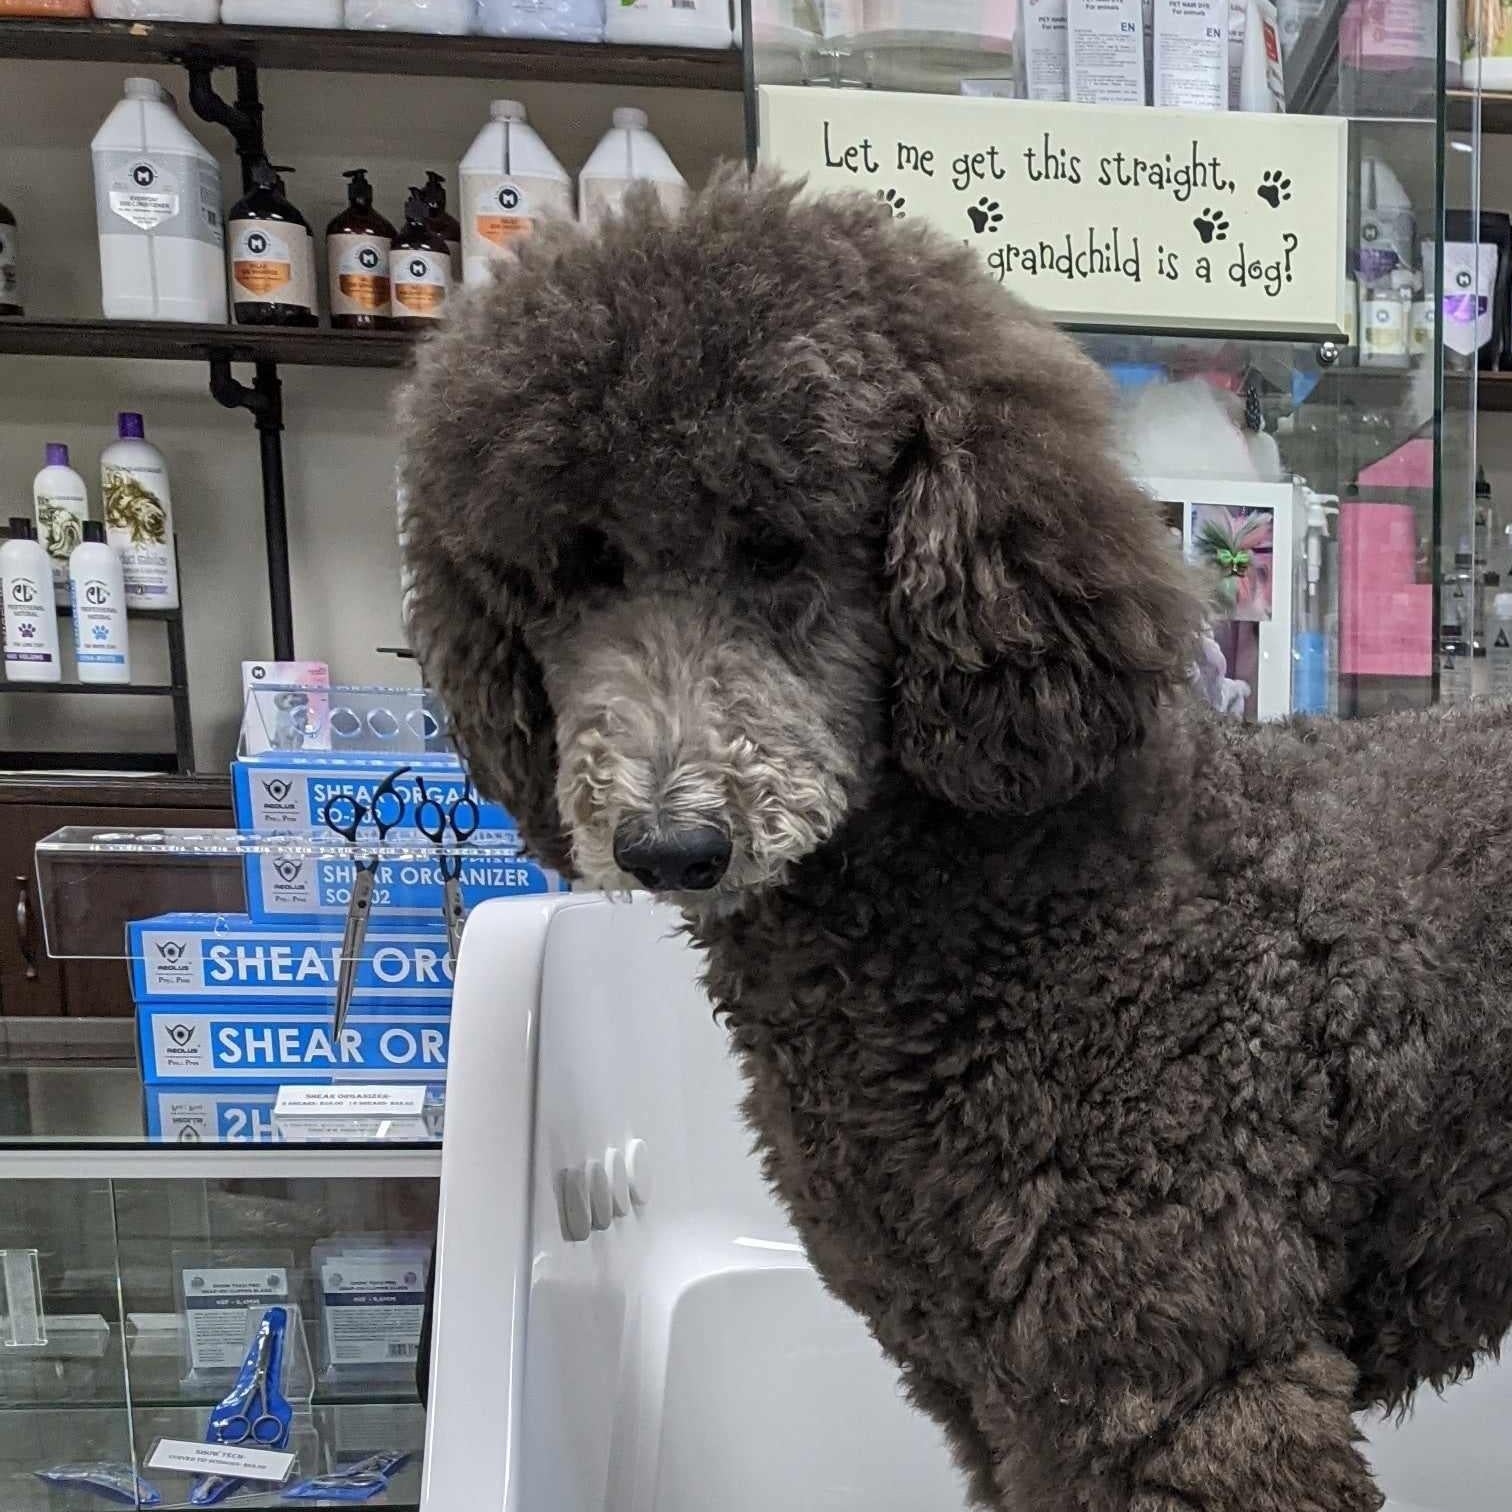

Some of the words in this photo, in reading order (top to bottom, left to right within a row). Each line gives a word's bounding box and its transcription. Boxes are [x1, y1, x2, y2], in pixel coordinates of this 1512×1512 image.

[1120, 22, 1136, 32] EN
[1206, 28, 1221, 38] EN
[823, 121, 879, 174] Let
[896, 142, 935, 177] me
[952, 145, 1006, 191] get
[1023, 132, 1082, 185] this
[1098, 140, 1236, 202] straight,
[987, 227, 1141, 283] grandchild
[1158, 245, 1179, 280] is
[1195, 256, 1212, 284] a
[1229, 233, 1299, 297] dog?
[218, 1027, 365, 1064] SHEAR
